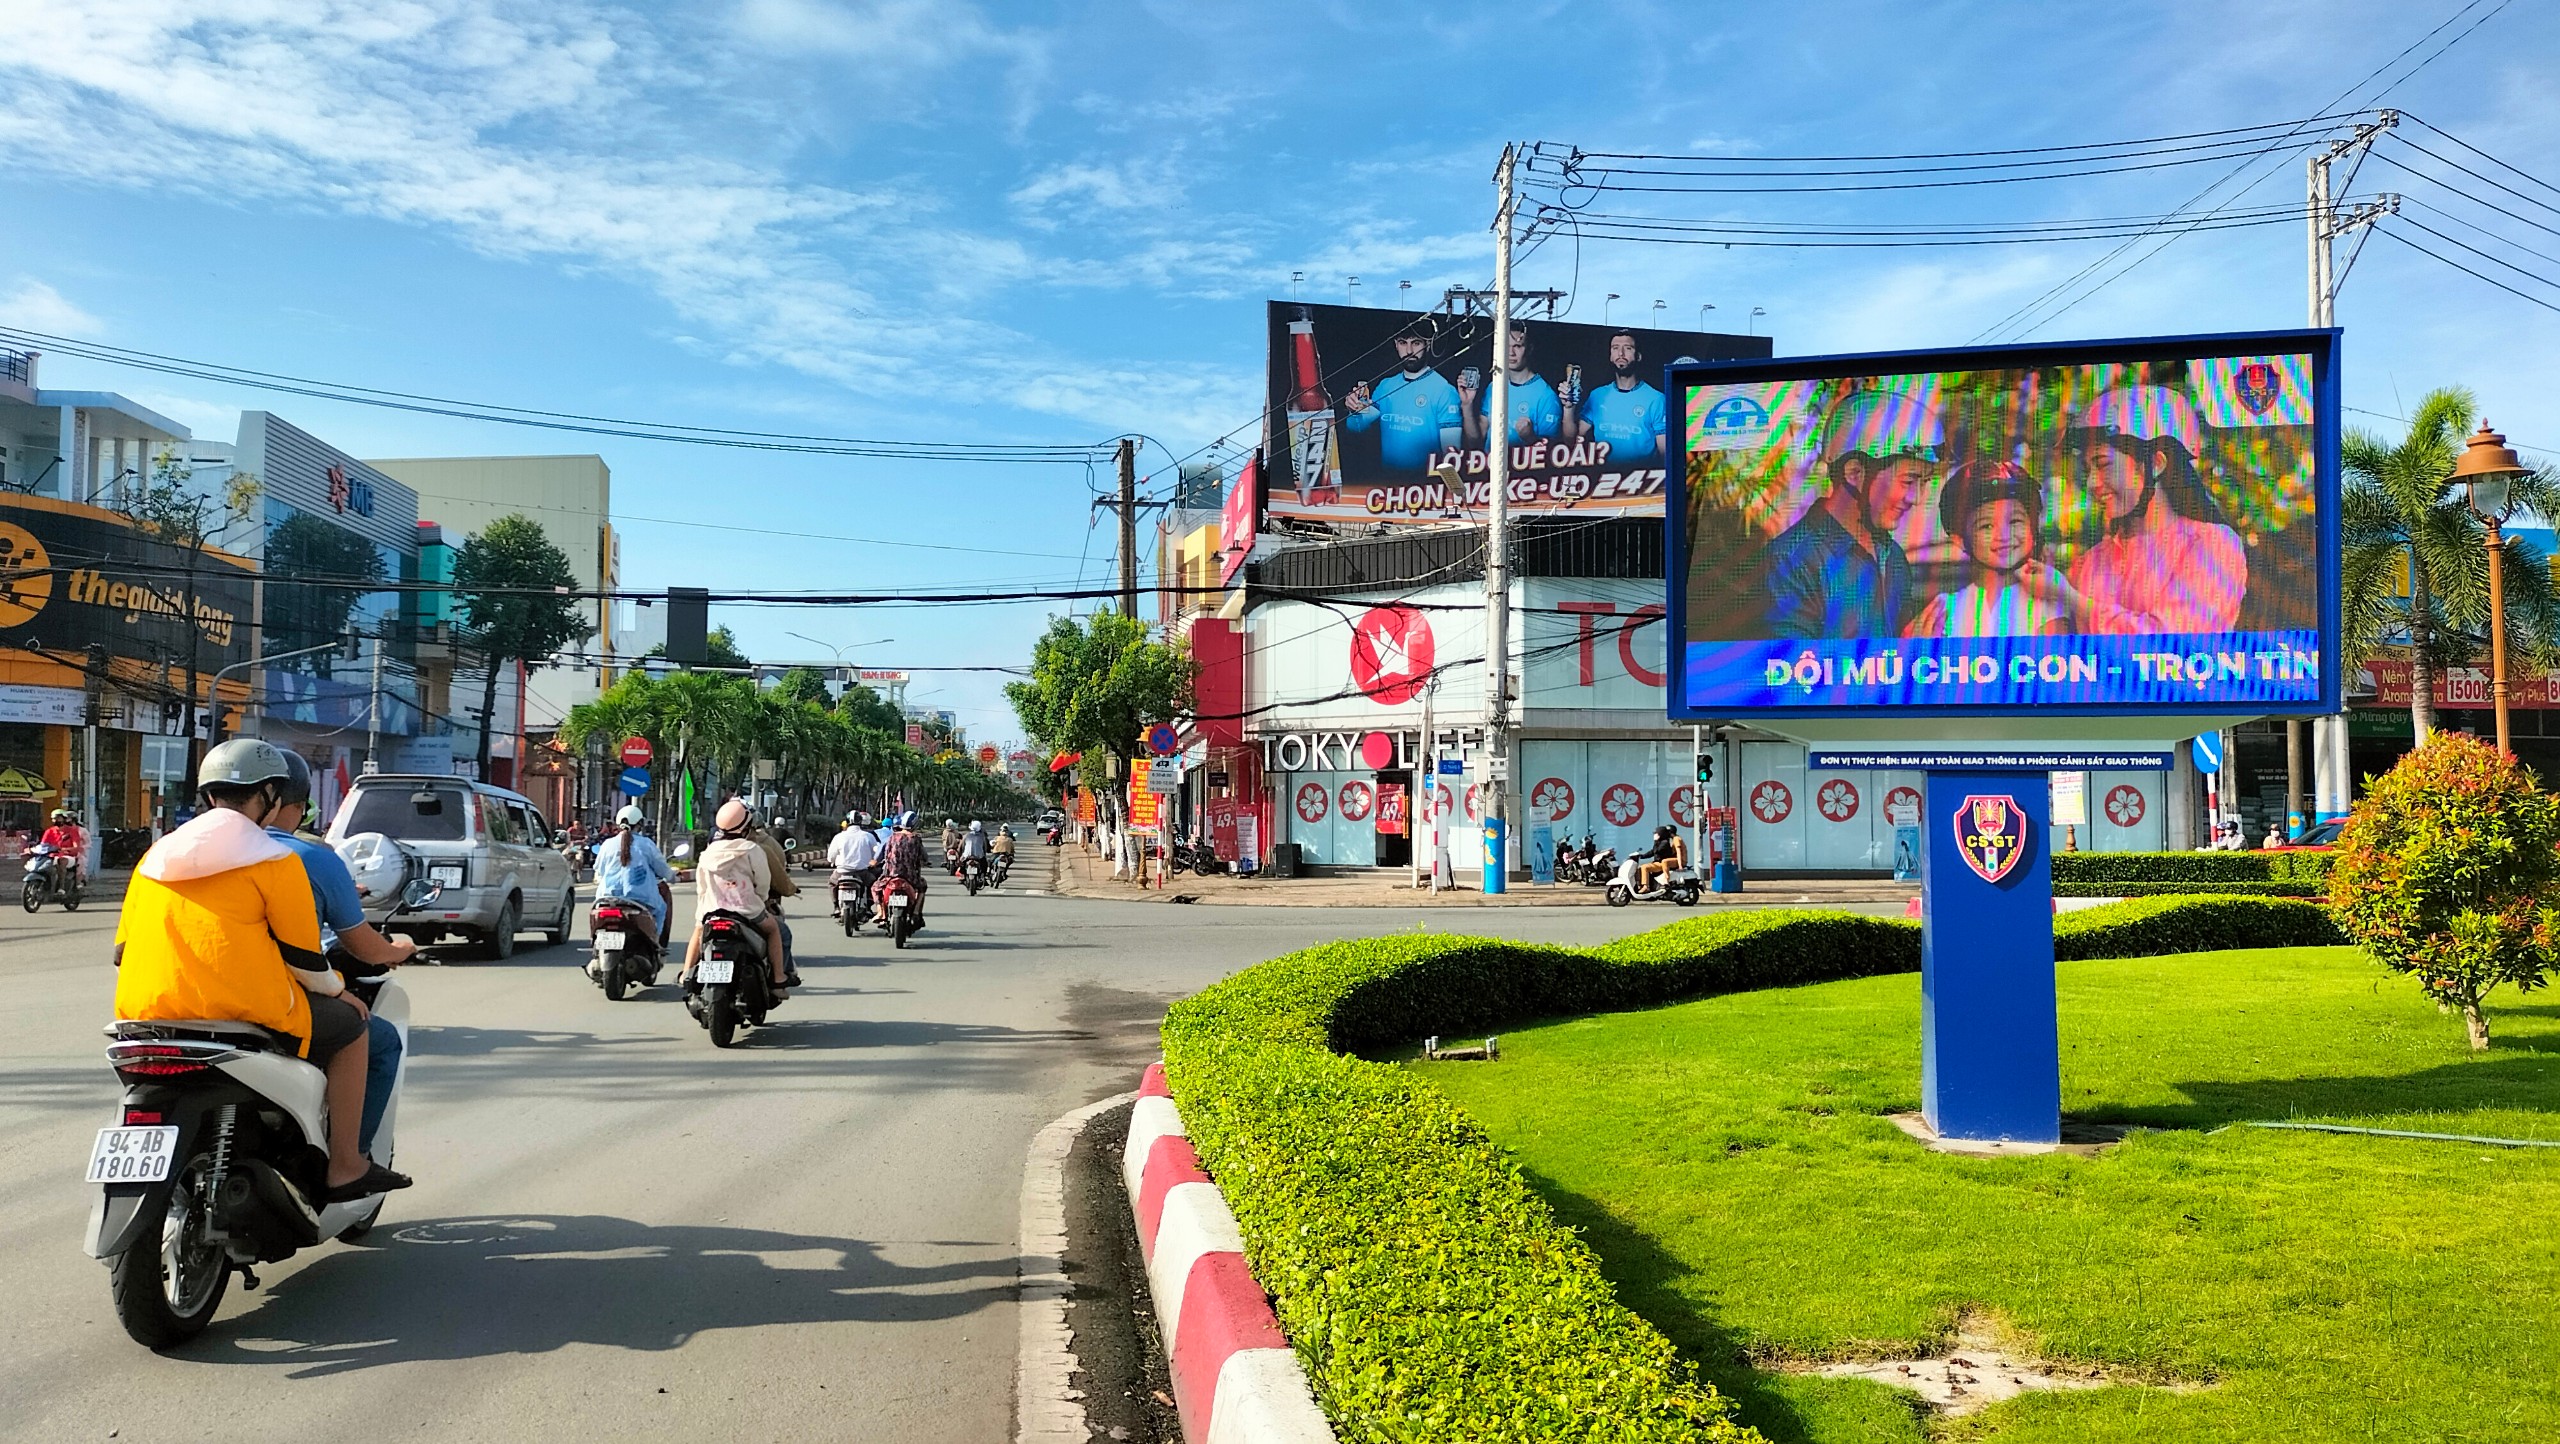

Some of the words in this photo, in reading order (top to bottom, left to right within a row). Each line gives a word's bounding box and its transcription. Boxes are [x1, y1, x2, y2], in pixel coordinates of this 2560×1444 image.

[1467, 449, 1492, 475] Đ
[1513, 437, 1548, 471] UỂ
[1551, 436, 1611, 468] OẢI?
[348, 478, 375, 518] MB
[1366, 484, 1445, 515] CHỌN
[1592, 469, 1667, 497] 247
[1765, 650, 1833, 694] ĐỘI
[1842, 650, 1903, 685] MŨ
[1911, 656, 2000, 684] CHO
[2008, 654, 2097, 683] CON
[2132, 652, 2246, 690] TRỌN
[2255, 643, 2319, 681] TÌN
[2382, 669, 2406, 687] Nệm
[2528, 689, 2546, 701] Plus
[1398, 728, 1480, 769] LFE
[1820, 757, 1840, 765] ĐƠN
[1841, 757, 1851, 767] VỊ
[1851, 757, 1876, 766] THỰC
[1876, 755, 1900, 766] HIỆN:
[1901, 757, 1920, 765] BAN
[1921, 757, 1933, 765] AN
[1935, 755, 1960, 765] TOÀN
[1962, 757, 1985, 765] GIAO
[1986, 755, 2017, 765] THÔNG
[2018, 757, 2025, 765] &
[2026, 755, 2058, 766] PHÒNG
[2059, 755, 2086, 765] CẢNH
[2086, 756, 2104, 765] SÁT
[2105, 757, 2129, 765] GIAO
[2129, 755, 2162, 765] THÔNG
[1966, 835, 1989, 848] CS
[1993, 835, 2016, 848] GT
[107, 1130, 165, 1154] 94-AB
[96, 1155, 167, 1179] 180.60
